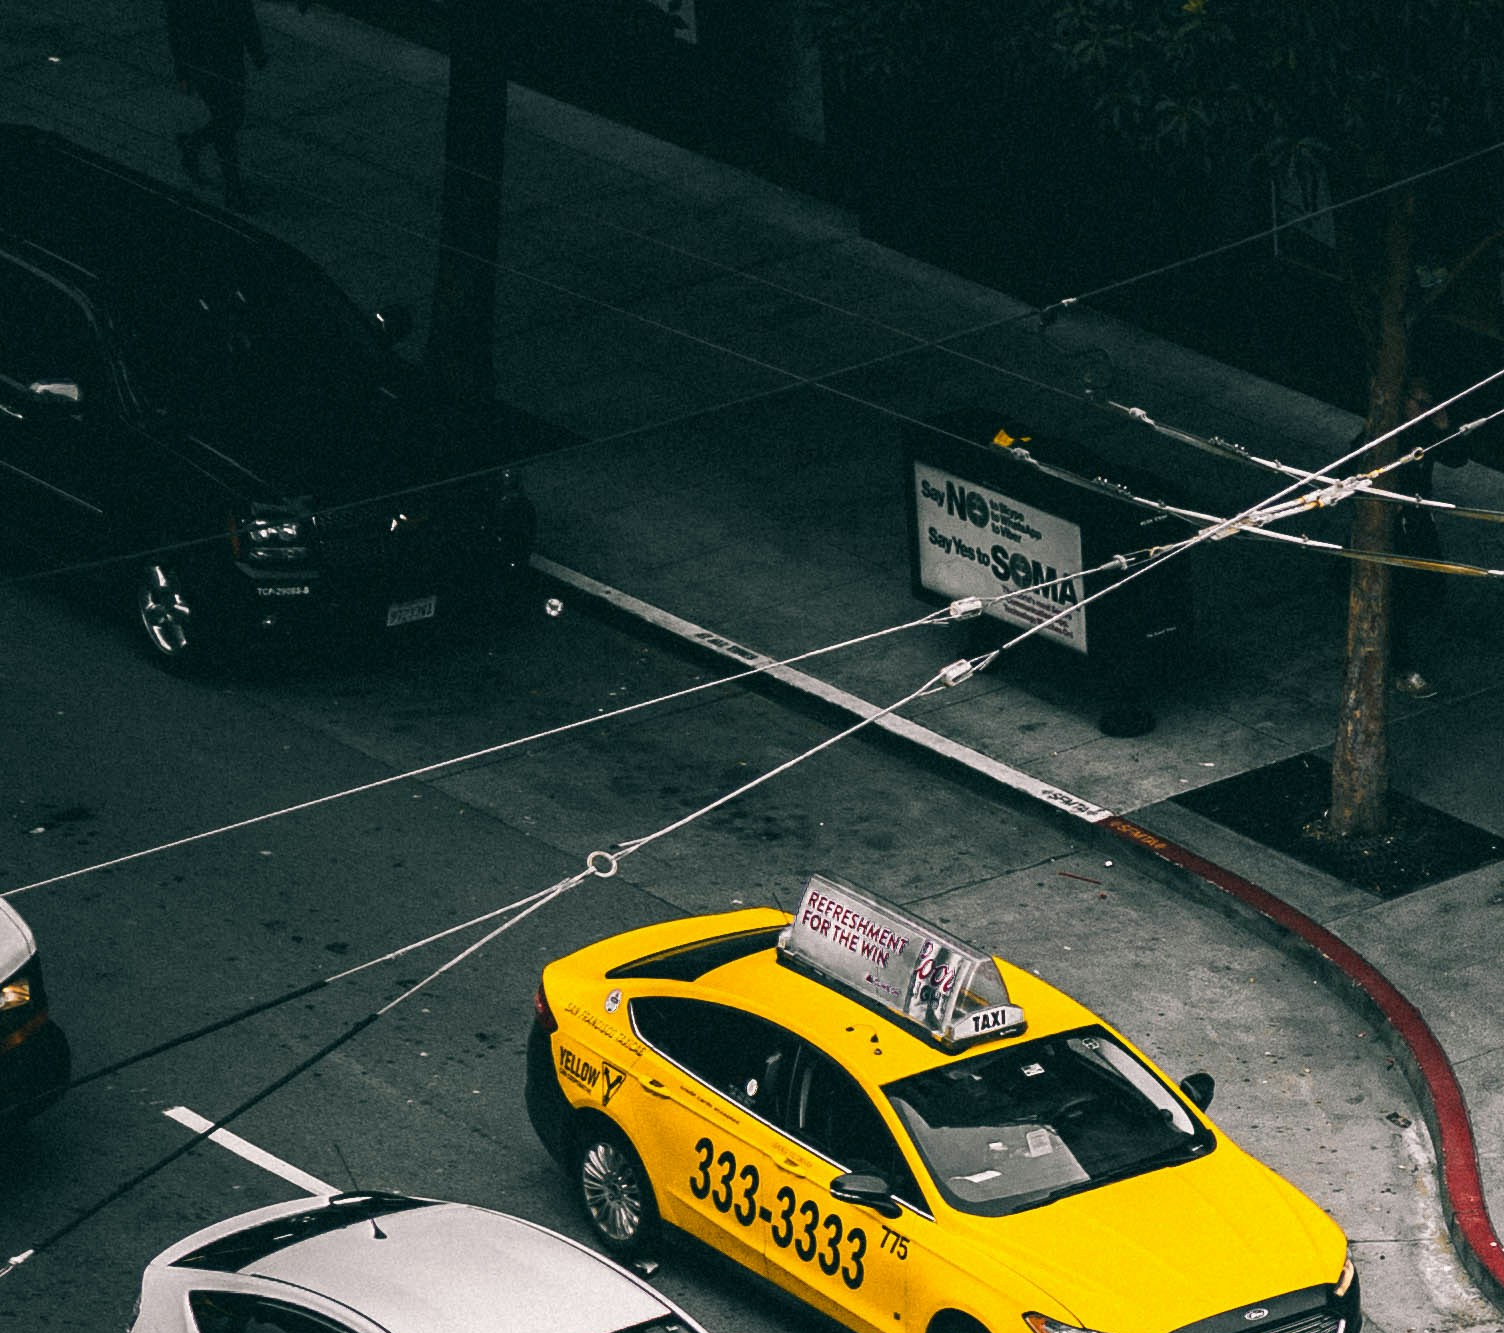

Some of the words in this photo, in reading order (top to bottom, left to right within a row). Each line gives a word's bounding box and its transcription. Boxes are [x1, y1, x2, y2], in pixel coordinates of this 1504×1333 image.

[921, 479, 945, 507] Say
[928, 526, 952, 554] Say
[951, 536, 976, 561] Yes
[976, 547, 990, 567] to
[802, 910, 832, 940] FOR
[833, 926, 859, 953] THE
[861, 941, 891, 969] WIN
[807, 891, 909, 955] REFRESHMENT
[972, 1008, 1006, 1032] TAXI
[559, 1046, 601, 1088] YELLOW
[690, 1137, 867, 1290] 333-3333
[880, 1225, 910, 1260] 775
